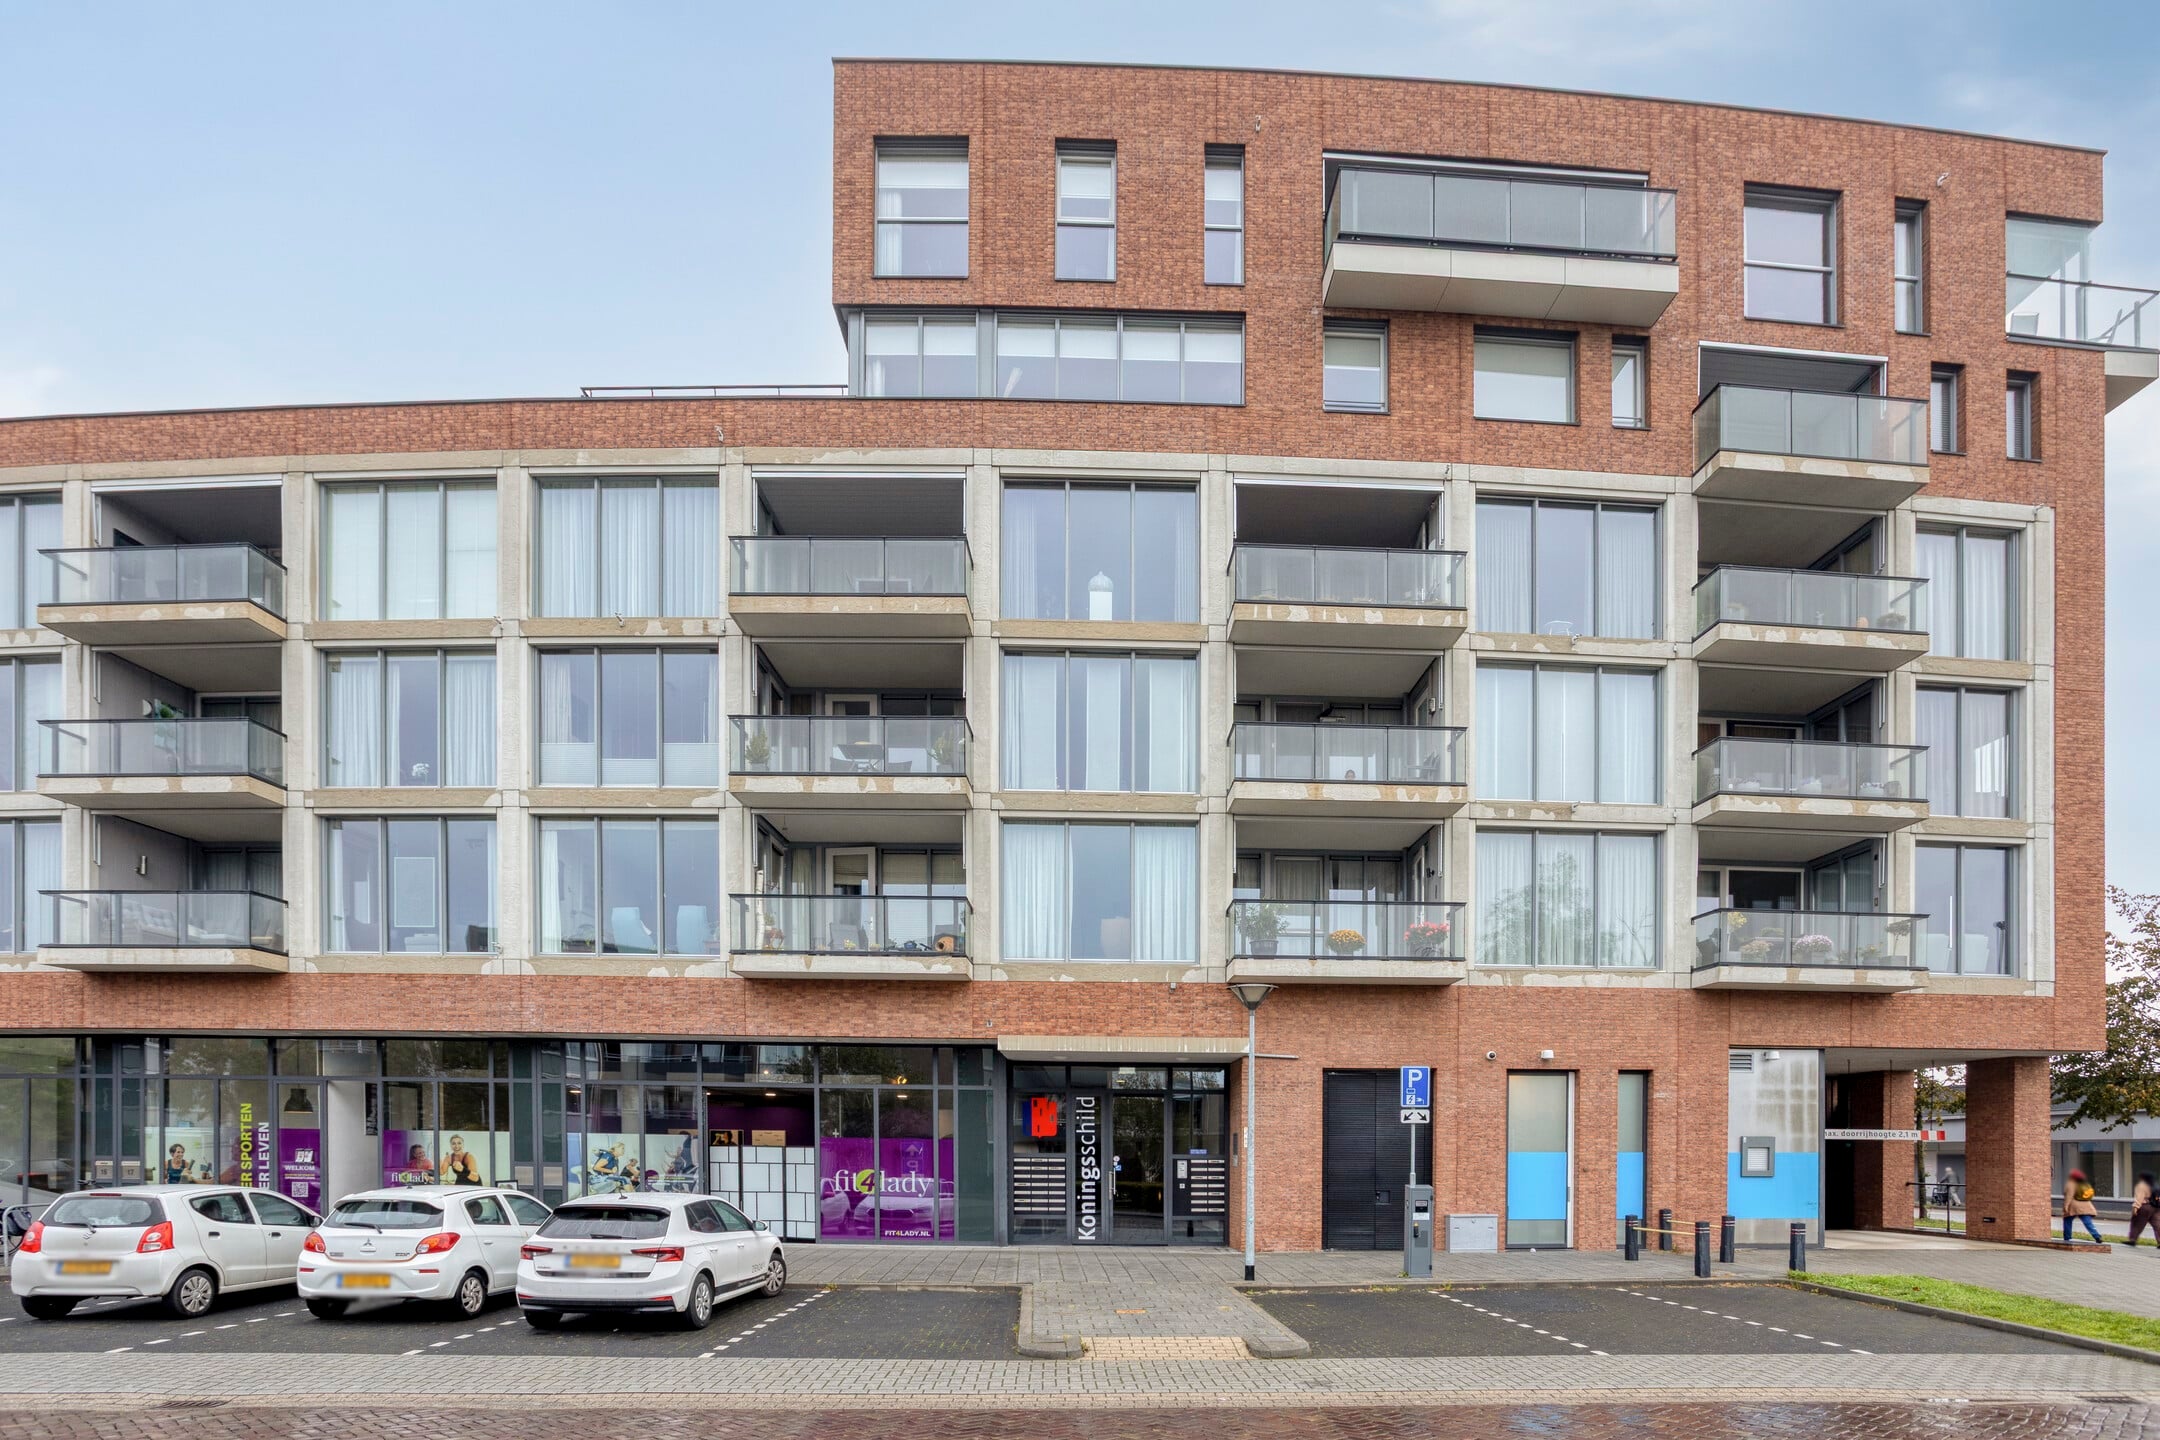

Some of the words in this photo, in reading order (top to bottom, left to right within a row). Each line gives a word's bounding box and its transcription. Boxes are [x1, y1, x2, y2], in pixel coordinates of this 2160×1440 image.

[1408, 1069, 1423, 1088] P
[241, 1103, 252, 1170] SPORTEN
[258, 1122, 269, 1169] LEVEN
[1841, 1130, 1896, 1138] doorrijhoogte
[1898, 1130, 1908, 1138] 2,1
[834, 1169, 931, 1197] fit4lady
[1076, 1096, 1101, 1240] Koningsschild
